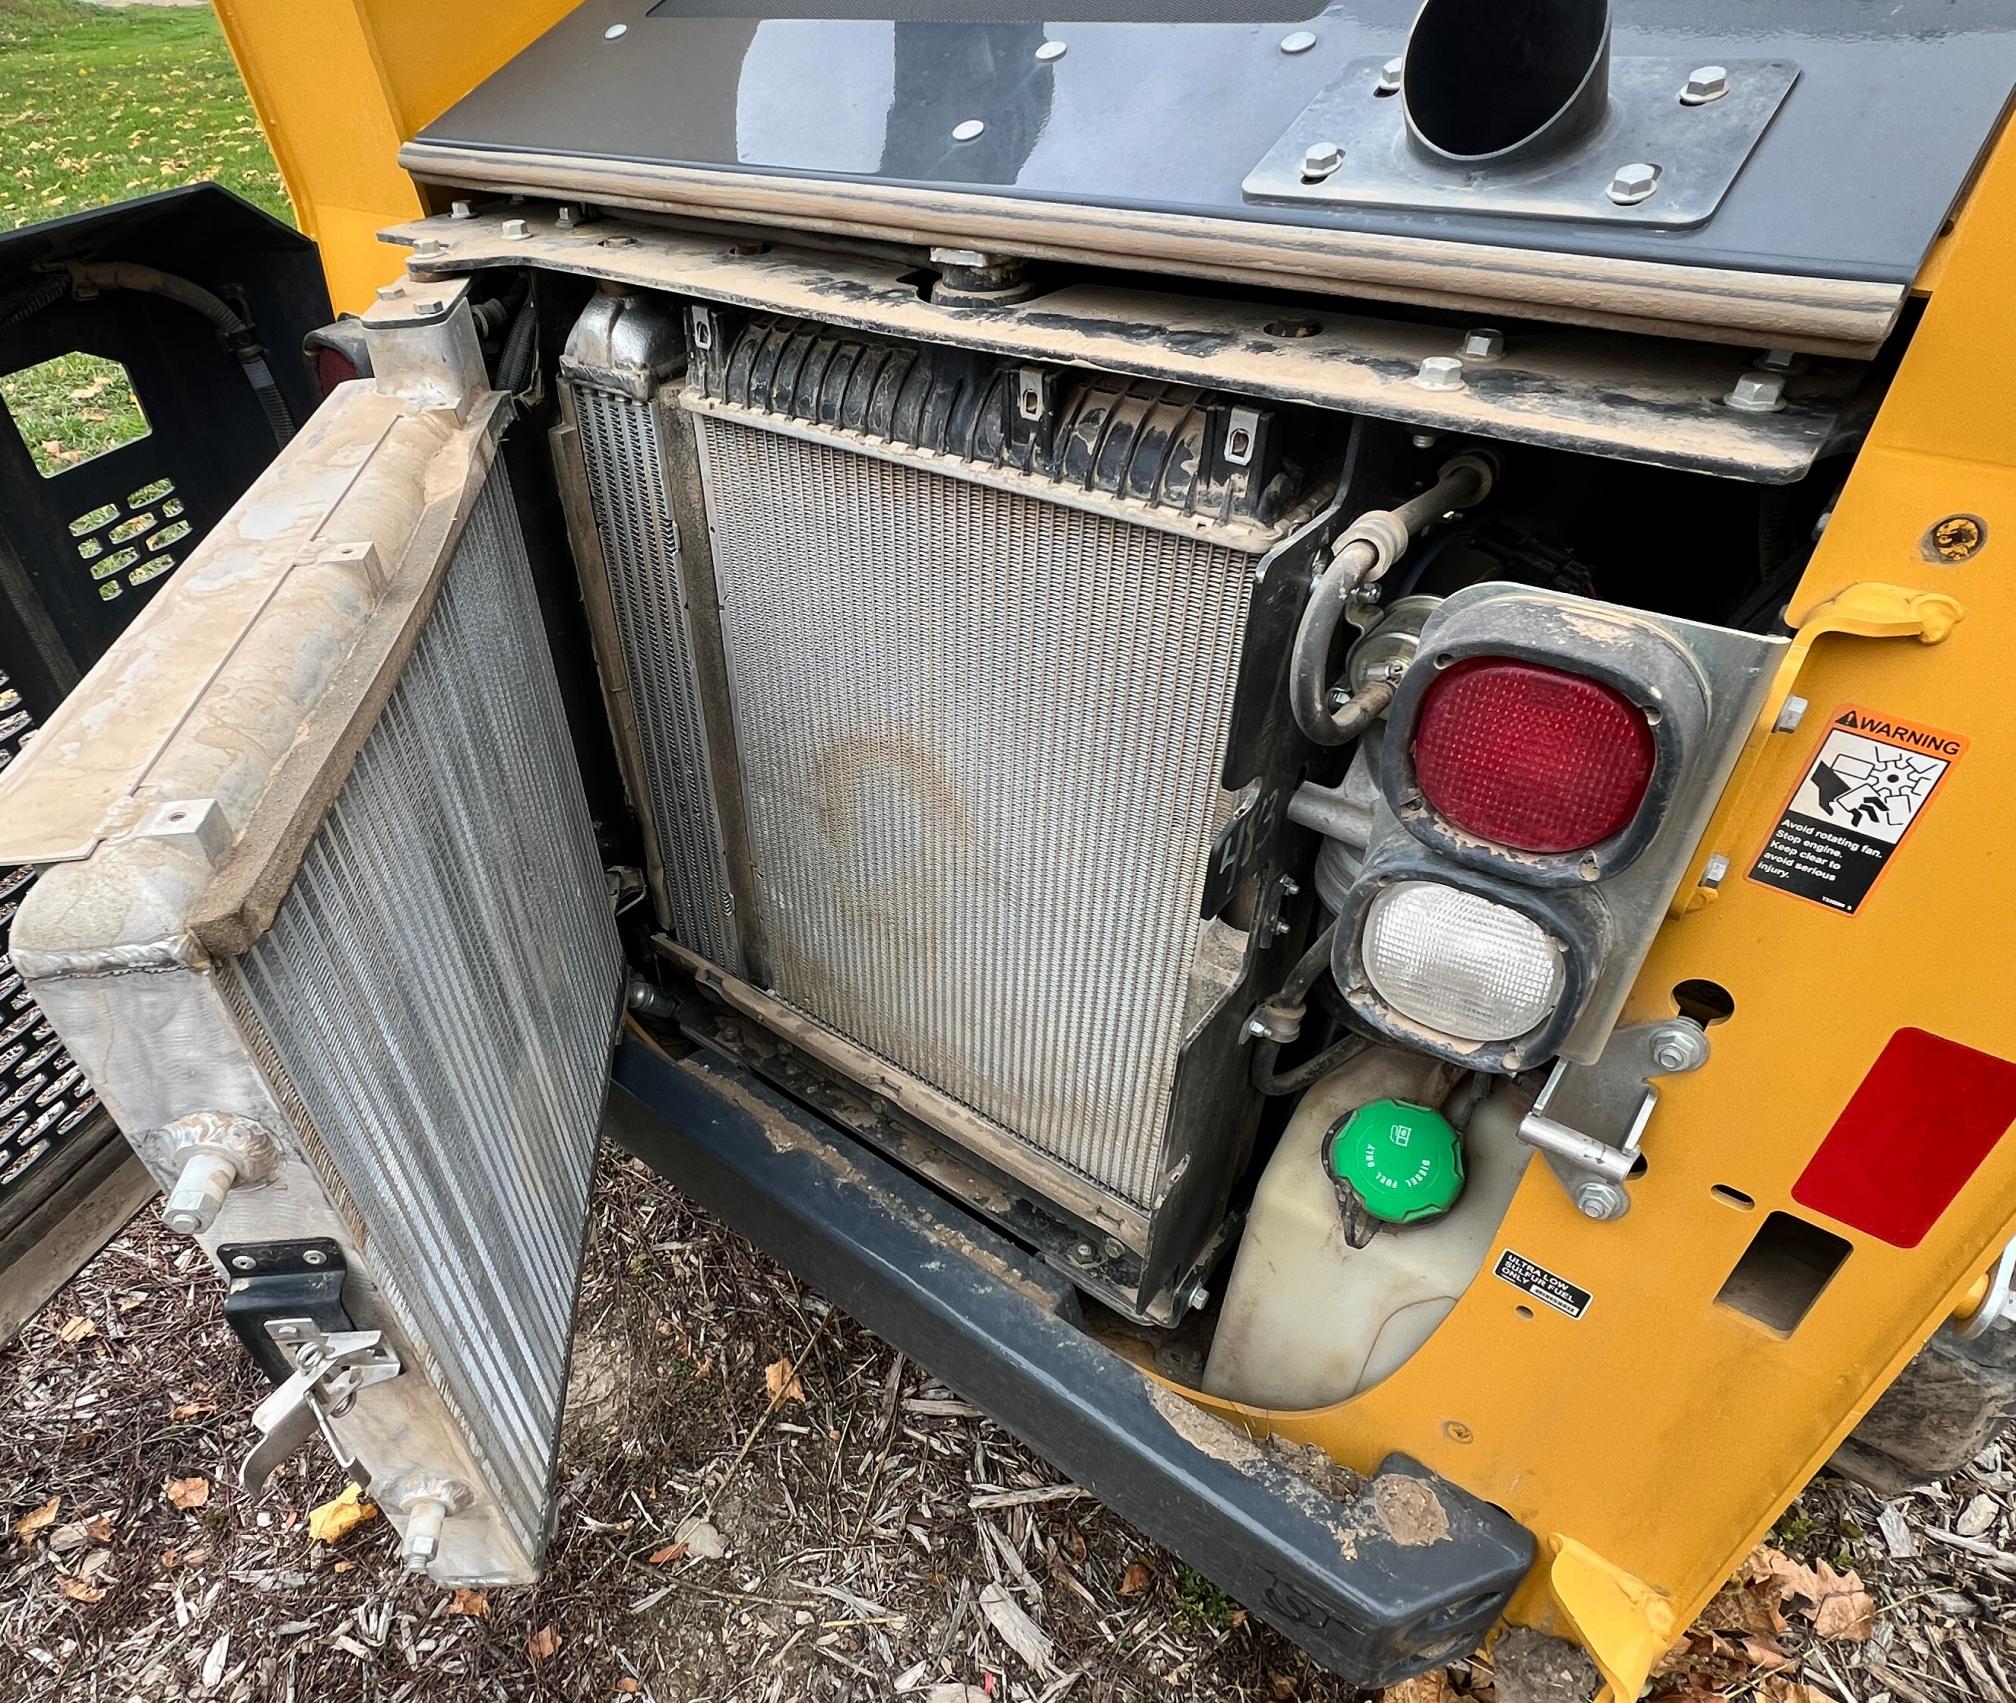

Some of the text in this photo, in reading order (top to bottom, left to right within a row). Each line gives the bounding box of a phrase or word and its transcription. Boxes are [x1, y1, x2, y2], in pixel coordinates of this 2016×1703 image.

[1860, 716, 1960, 755] WARNING
[1770, 840, 1841, 870] Keep clear to
[1775, 829, 1843, 858] Stop engine.
[1781, 819, 1883, 858] Avoid rotating fan.
[1757, 861, 1790, 879] injury.
[1763, 851, 1836, 882] avoid serious
[1365, 1143, 1431, 1189] DIESEL FUEL ONLY
[1501, 1267, 1530, 1285] ONLY
[1504, 1260, 1546, 1288] SULFUR
[1547, 1284, 1575, 1304] FUEL
[1508, 1254, 1541, 1278] ULTRA
[1543, 1273, 1569, 1291] LOW
